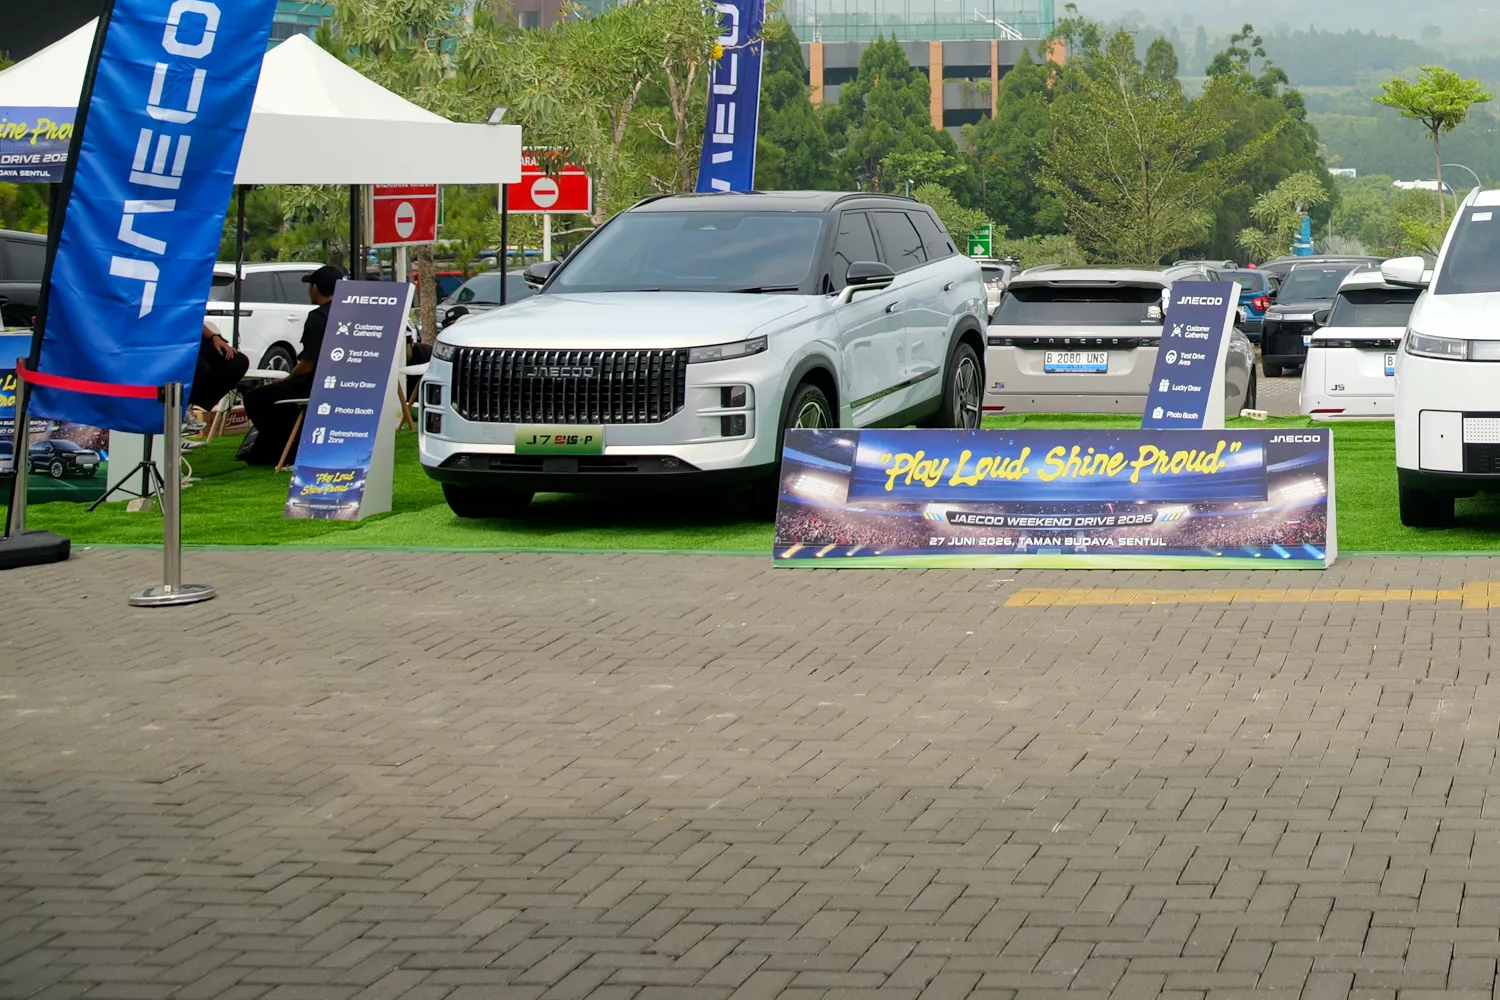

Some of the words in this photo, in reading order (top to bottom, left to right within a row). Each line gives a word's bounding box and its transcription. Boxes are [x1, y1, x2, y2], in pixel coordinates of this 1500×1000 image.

[0, 118, 29, 140] ine
[1, 155, 40, 164] DRIVE
[43, 153, 68, 163] 202
[342, 296, 397, 305] JAECOO
[1177, 296, 1223, 306] JAECOO
[354, 323, 384, 331] Customer
[352, 330, 382, 338] Gathering
[1047, 353, 1053, 363] B
[1087, 353, 1105, 363] UNS
[1387, 356, 1394, 366] B
[527, 367, 594, 377] JAECOO
[1172, 384, 1188, 392] Lucky
[354, 407, 374, 415] Booth
[1183, 412, 1198, 420] Booth
[329, 430, 369, 438] Refreshment
[1270, 435, 1320, 443] JAECOO
[1037, 445, 1128, 482] Shine
[950, 515, 1005, 526] JAECOO
[1007, 516, 1074, 527] WEEKEND
[1074, 516, 1115, 527] DRIVE
[1117, 513, 1153, 524] 2026
[929, 537, 946, 546] 27
[948, 537, 976, 546] JUNI
[978, 537, 1015, 547] 2026,
[1018, 537, 1063, 546] TAMAN
[1064, 537, 1114, 546] BUDAYA
[1118, 537, 1167, 546] SENTUL
